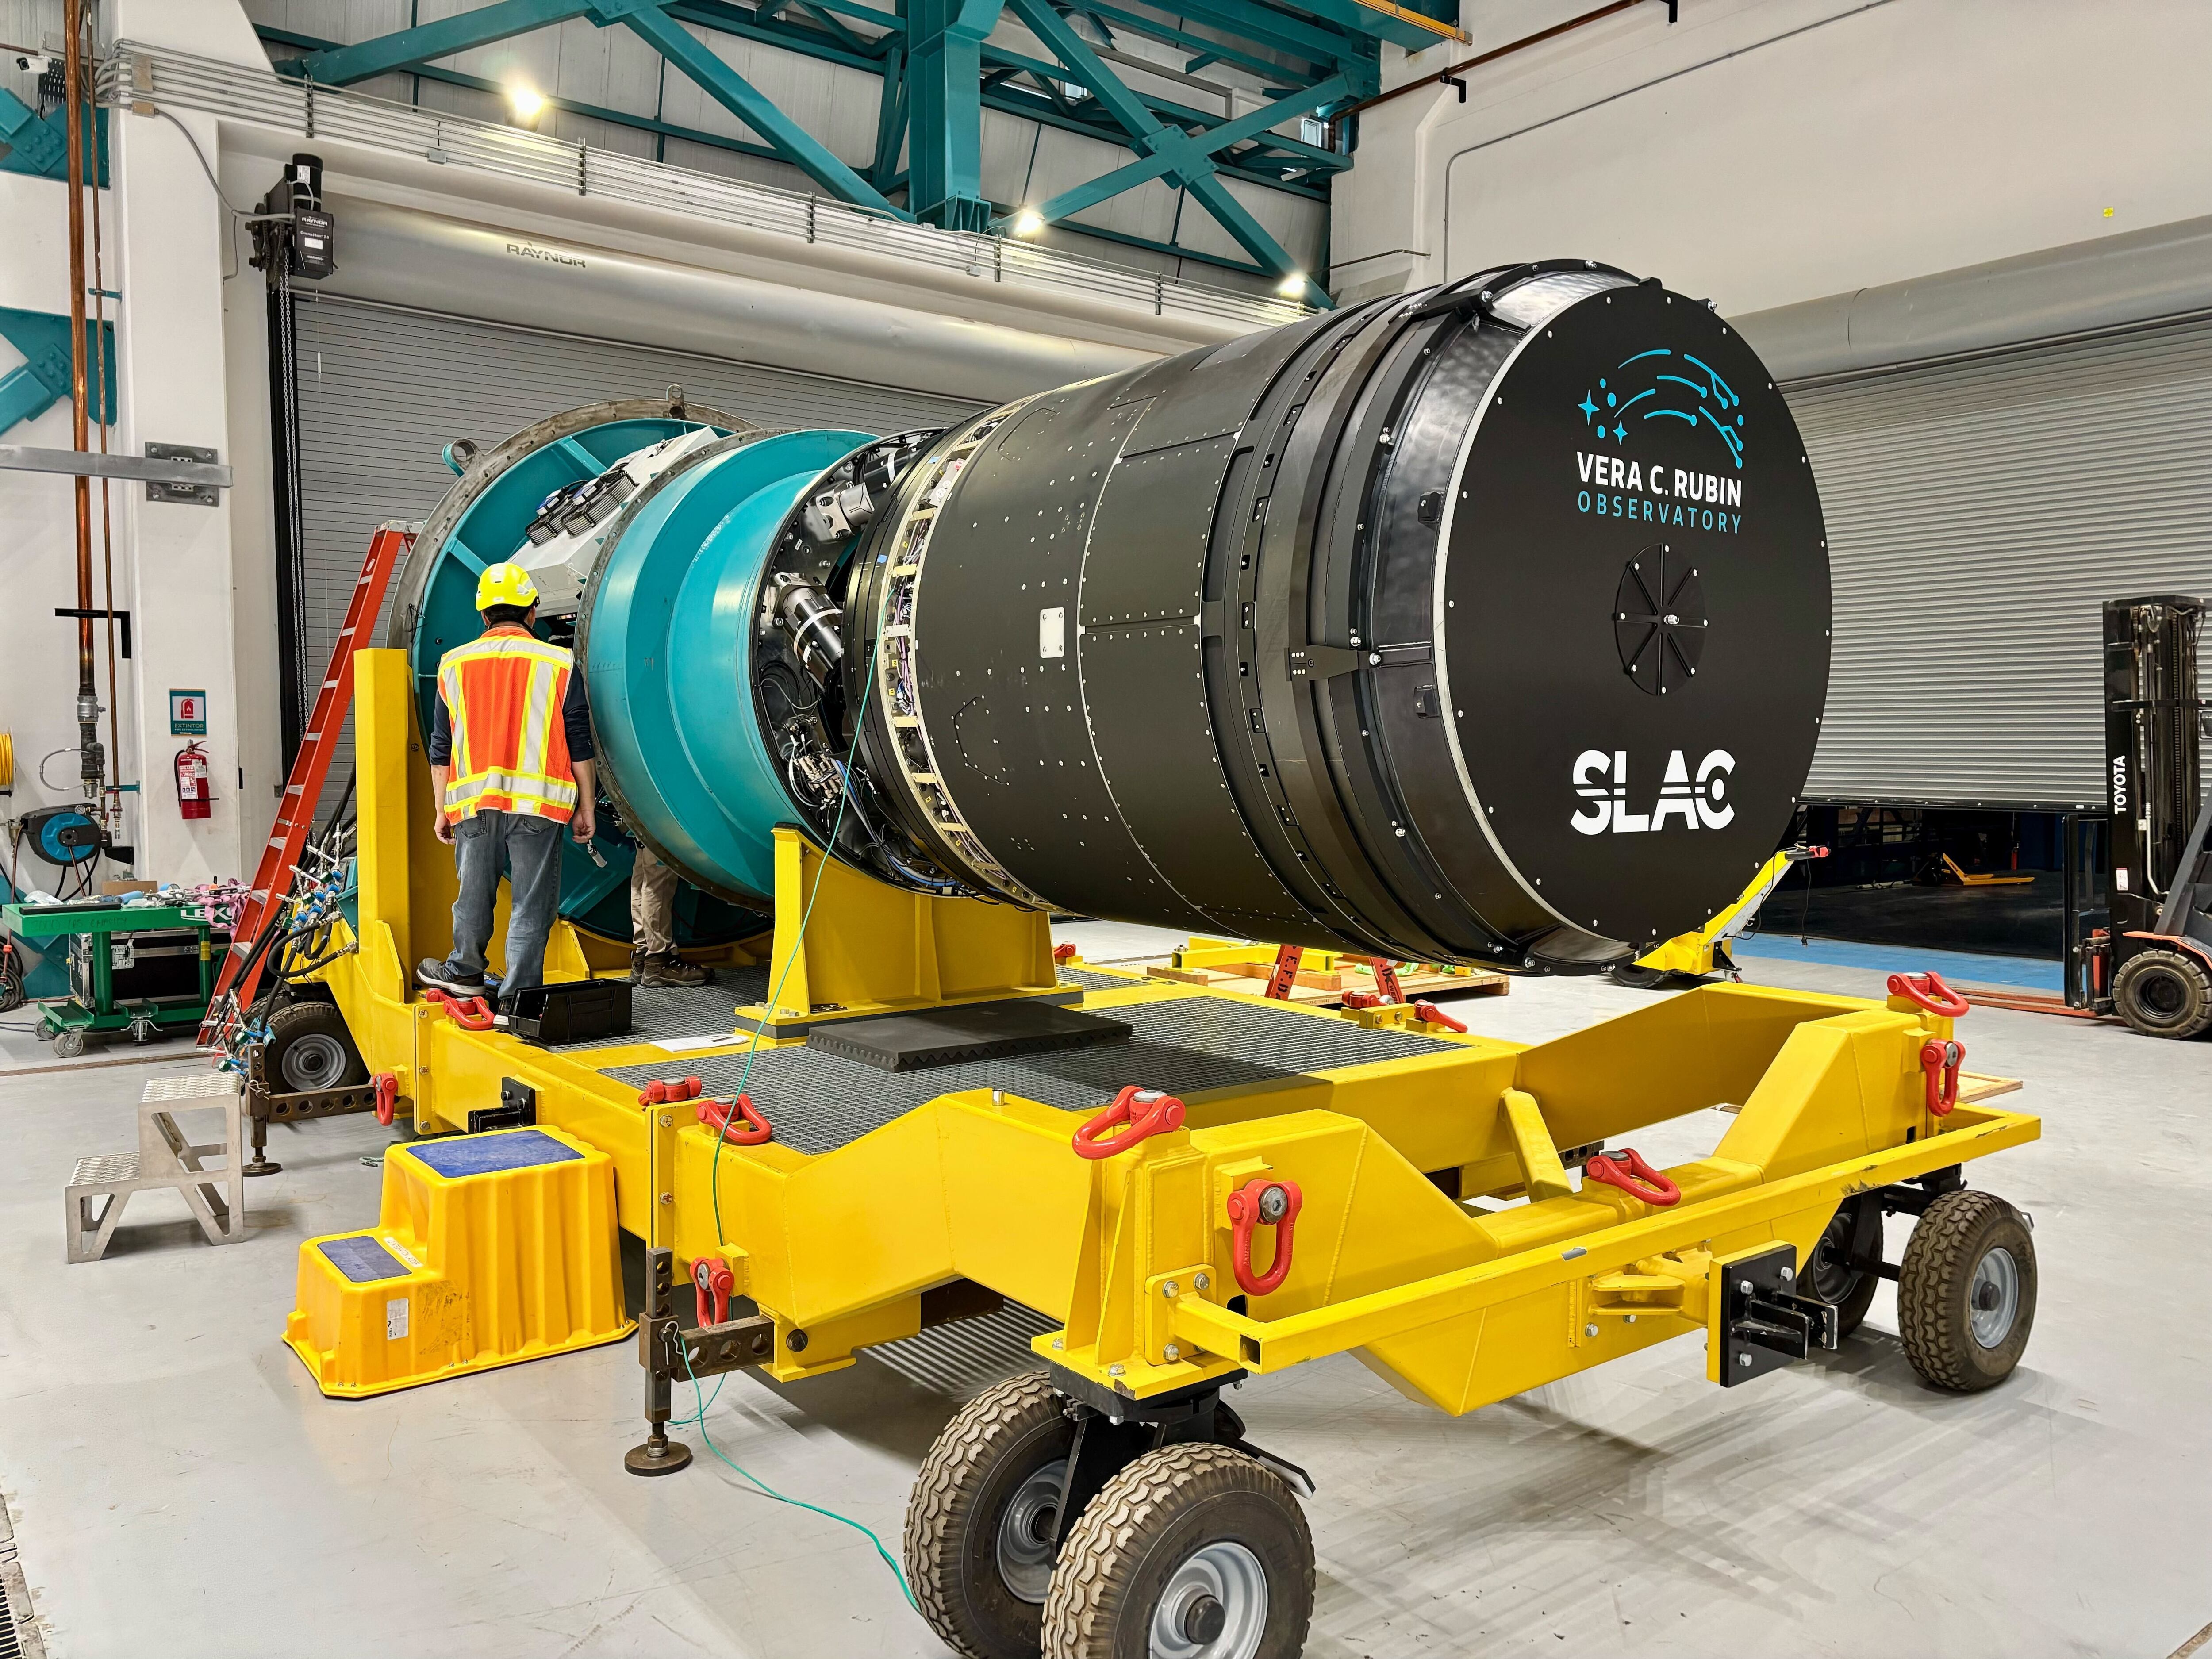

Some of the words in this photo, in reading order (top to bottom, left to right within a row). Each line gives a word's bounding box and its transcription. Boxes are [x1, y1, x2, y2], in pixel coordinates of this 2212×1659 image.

[302, 217, 327, 226] RAYNOR
[507, 243, 586, 268] RAYNOR
[1577, 451, 1643, 492] VERA
[1650, 465, 1668, 495] C.
[1674, 468, 1741, 507] RUBIN
[1578, 490, 1741, 534] OBSERVATORY
[1570, 749, 1736, 835] SLAC
[2113, 755, 2127, 814] TOYOTA
